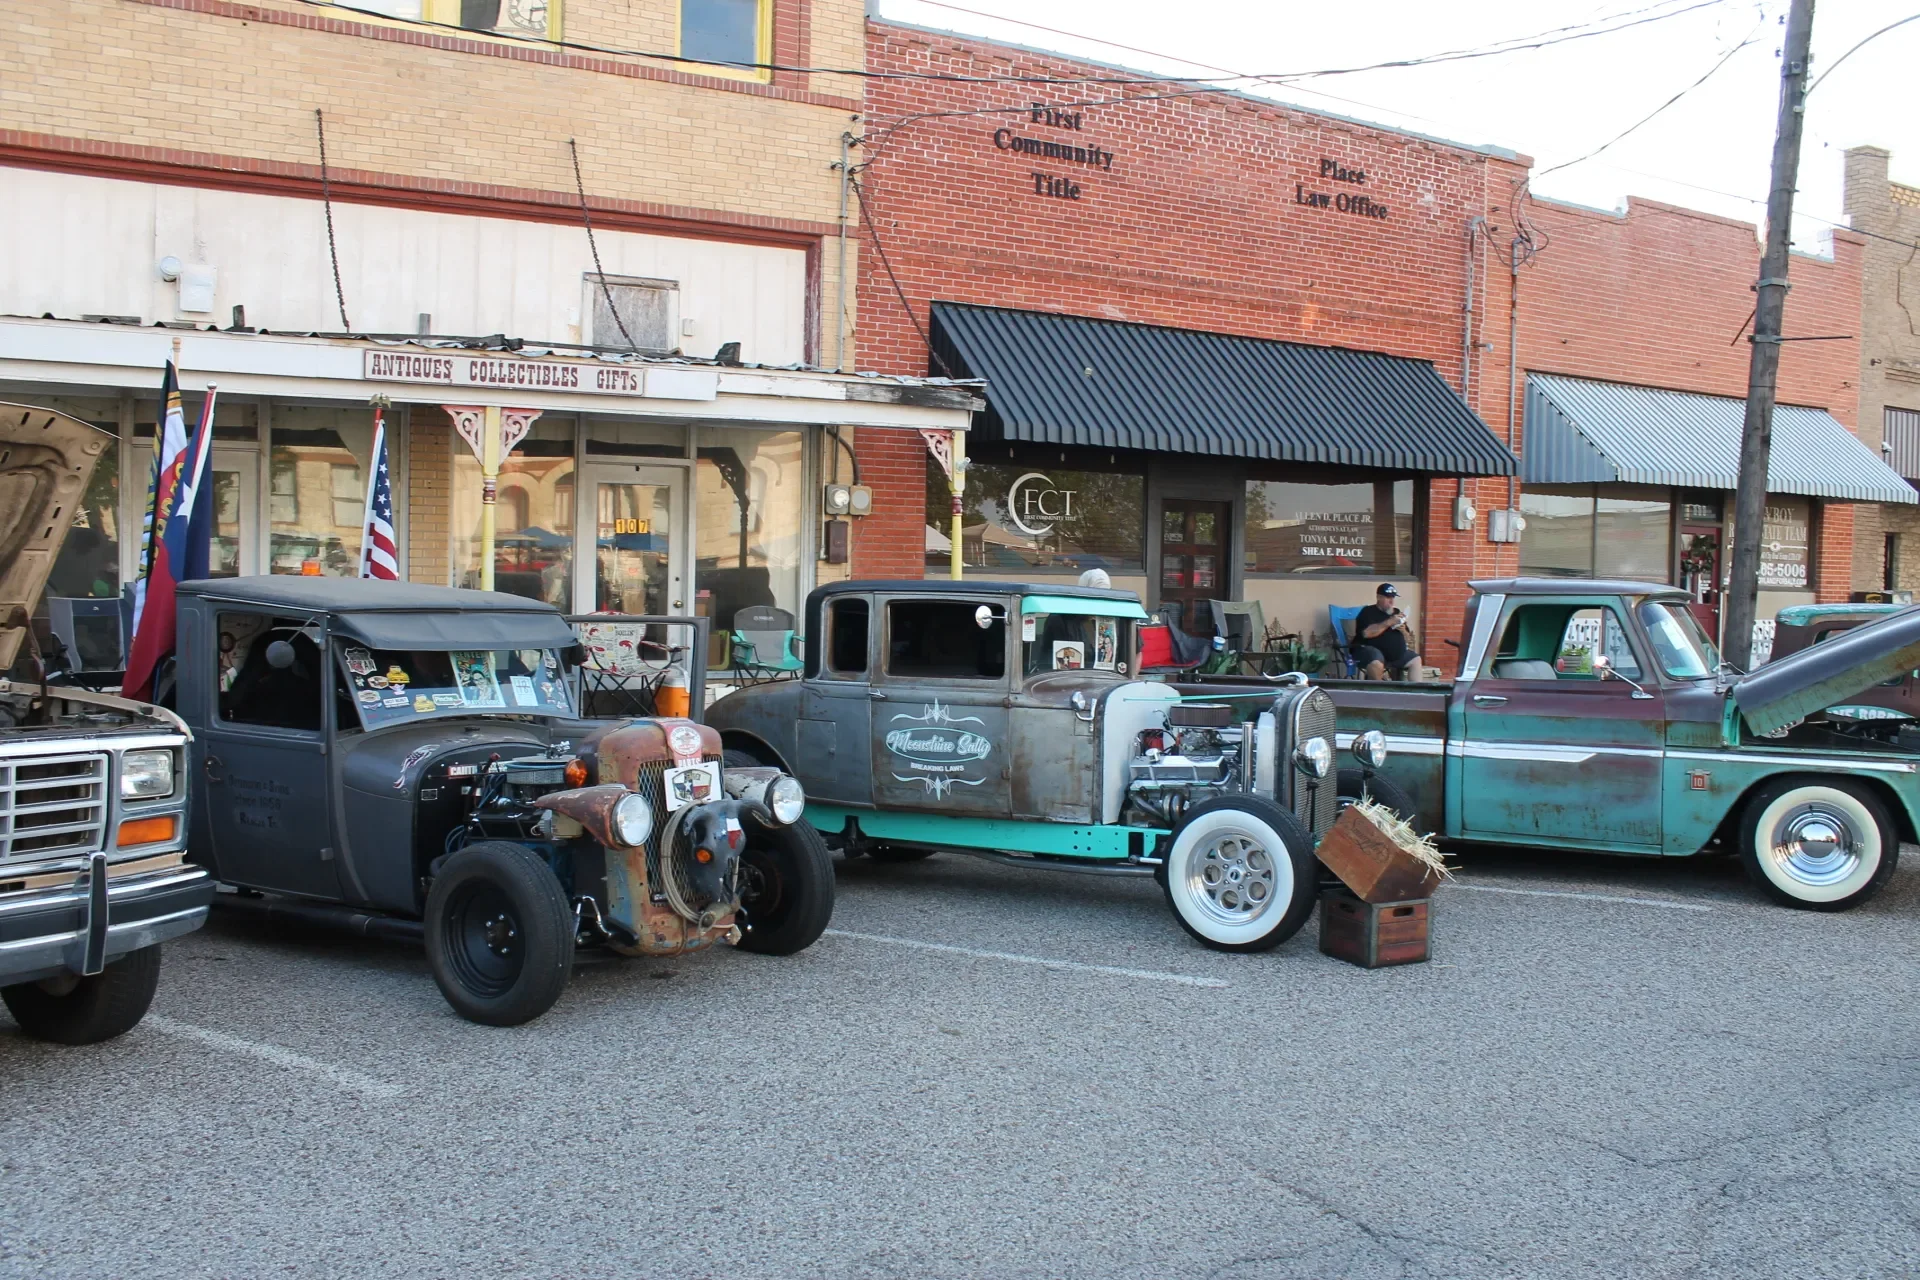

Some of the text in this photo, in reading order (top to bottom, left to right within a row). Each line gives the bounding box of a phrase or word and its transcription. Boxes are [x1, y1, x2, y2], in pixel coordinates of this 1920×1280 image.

[1031, 102, 1081, 130] First
[994, 128, 1114, 170] Community
[1320, 159, 1365, 184] Place
[1031, 172, 1080, 200] Title
[1296, 184, 1387, 219] Law Office
[371, 353, 452, 379] ANTIQUES
[469, 360, 578, 387] COLLECTIBLES
[1024, 488, 1077, 516] FCT
[616, 519, 648, 533] 107
[1295, 511, 1321, 521] ALLEN
[1333, 513, 1360, 523] PLACE
[1361, 514, 1373, 523] JR.
[1299, 534, 1328, 544] TONYA
[1340, 536, 1367, 545] PLACE
[1785, 527, 1807, 542] TEAM
[1302, 546, 1325, 556] SHEA
[1336, 548, 1363, 557] PLACE
[1755, 562, 1806, 578] 65-5006
[886, 729, 991, 760] Moonshine Sally
[910, 762, 944, 772] BREAKING
